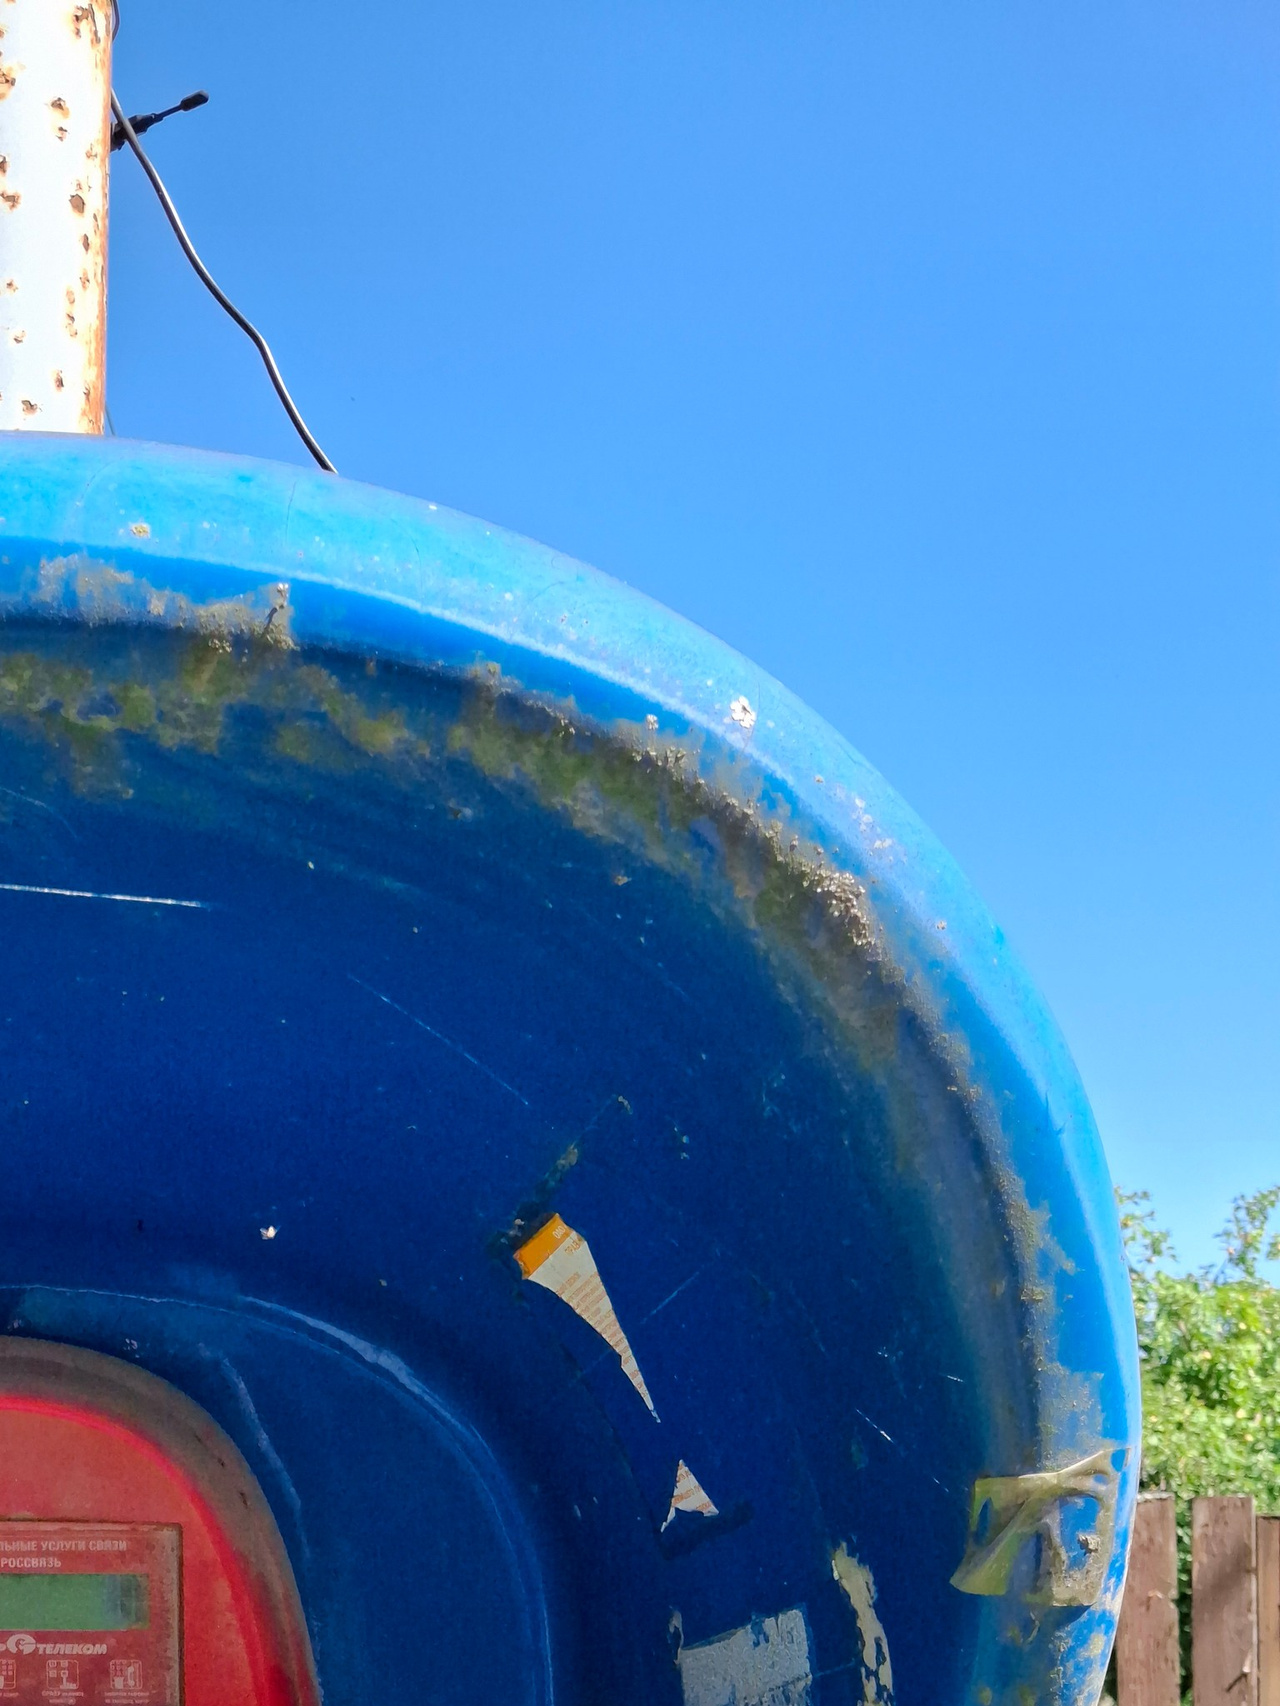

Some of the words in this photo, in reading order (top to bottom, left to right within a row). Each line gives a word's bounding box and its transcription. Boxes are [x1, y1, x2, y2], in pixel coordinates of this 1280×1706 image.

[41, 1540, 87, 1552] УСЛУГИ
[88, 1540, 127, 1552] СВЯЗИ
[0, 1557, 62, 1569] РОССВЯЗЬ
[35, 1643, 108, 1656] ТЕЛЕКОМ
